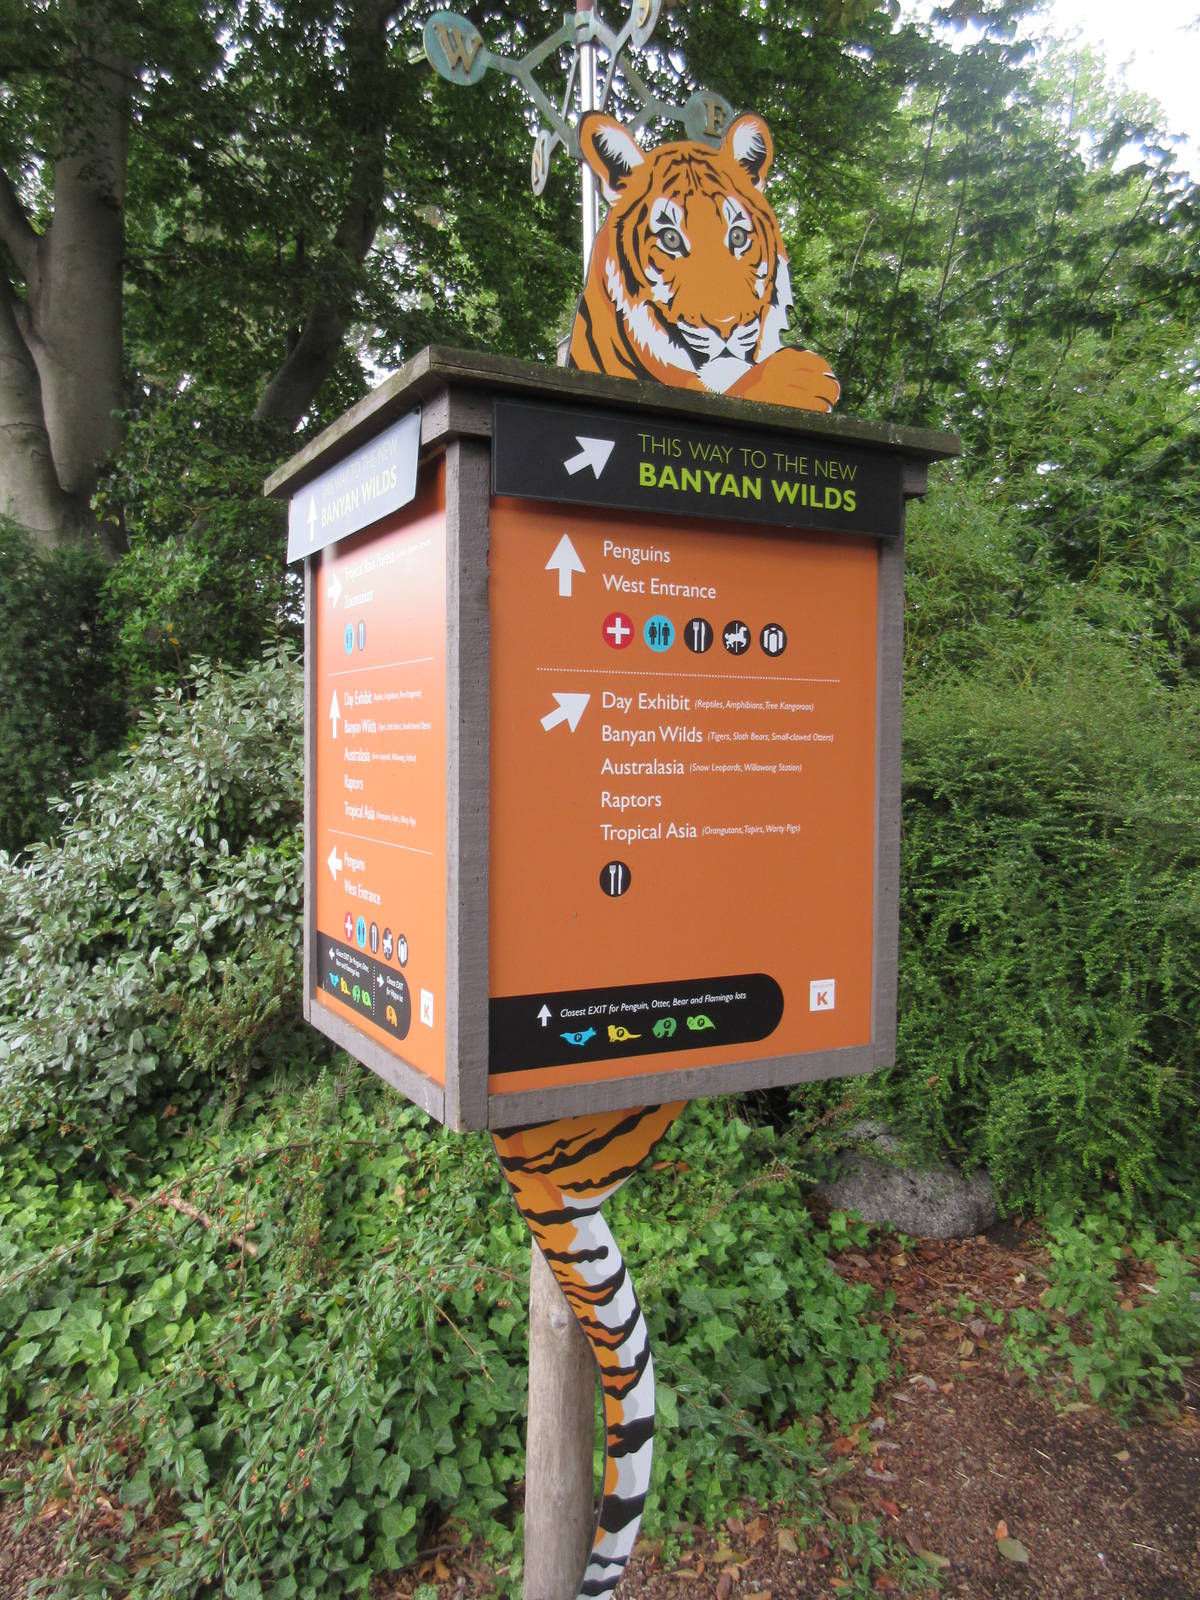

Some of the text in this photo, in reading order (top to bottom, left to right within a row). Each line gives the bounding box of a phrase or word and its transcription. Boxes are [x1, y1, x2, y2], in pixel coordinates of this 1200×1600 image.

[433, 23, 484, 75] W
[637, 433, 858, 481] THIS WAY TO THE NEW
[321, 464, 398, 529] BANYAN WILDS
[639, 462, 857, 512] BANYAN WILDS
[603, 540, 671, 565] Penguins
[602, 573, 717, 599] West Entrance
[602, 692, 632, 714] Day
[638, 692, 690, 711] Exhibit
[726, 700, 765, 711] Amphibians,
[765, 701, 778, 710] Tree
[601, 725, 656, 747] Banyan
[659, 726, 703, 744] Wilds
[733, 731, 749, 741] Sloth
[600, 758, 685, 776] Australasia
[689, 763, 709, 773] (Snow
[600, 791, 662, 812] Raptors
[600, 823, 661, 844] Tropical
[666, 822, 697, 839] Asia
[560, 991, 747, 1018] Closest EXIT for Penguin, Otter, Bear and Flamingo lots
[817, 991, 829, 1006] K
